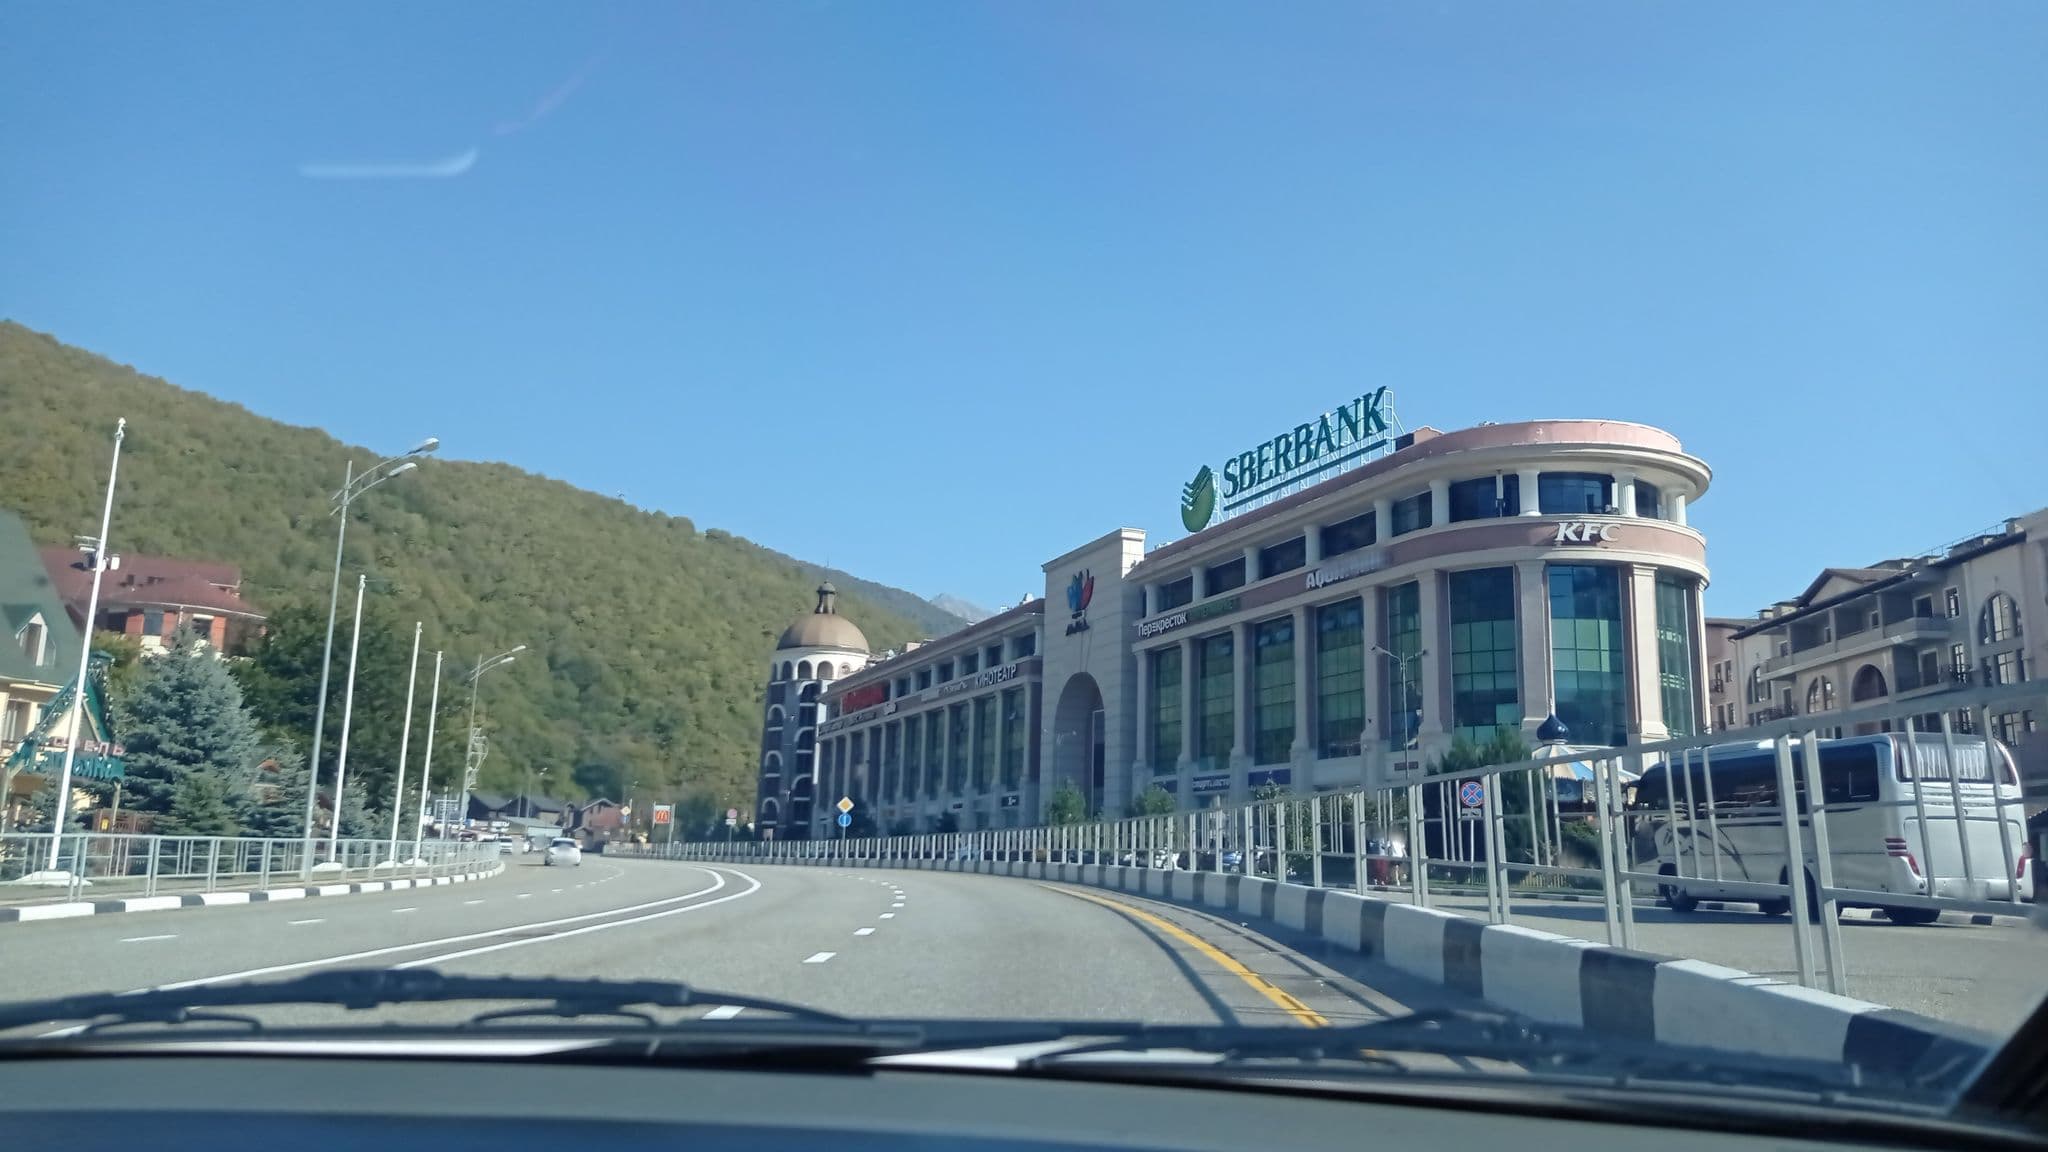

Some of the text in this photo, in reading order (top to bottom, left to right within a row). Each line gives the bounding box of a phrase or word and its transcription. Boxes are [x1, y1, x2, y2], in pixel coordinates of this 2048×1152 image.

[1223, 385, 1388, 499] SBERBANK
[1554, 522, 1622, 542] KFC
[1138, 611, 1188, 637] Перекресток
